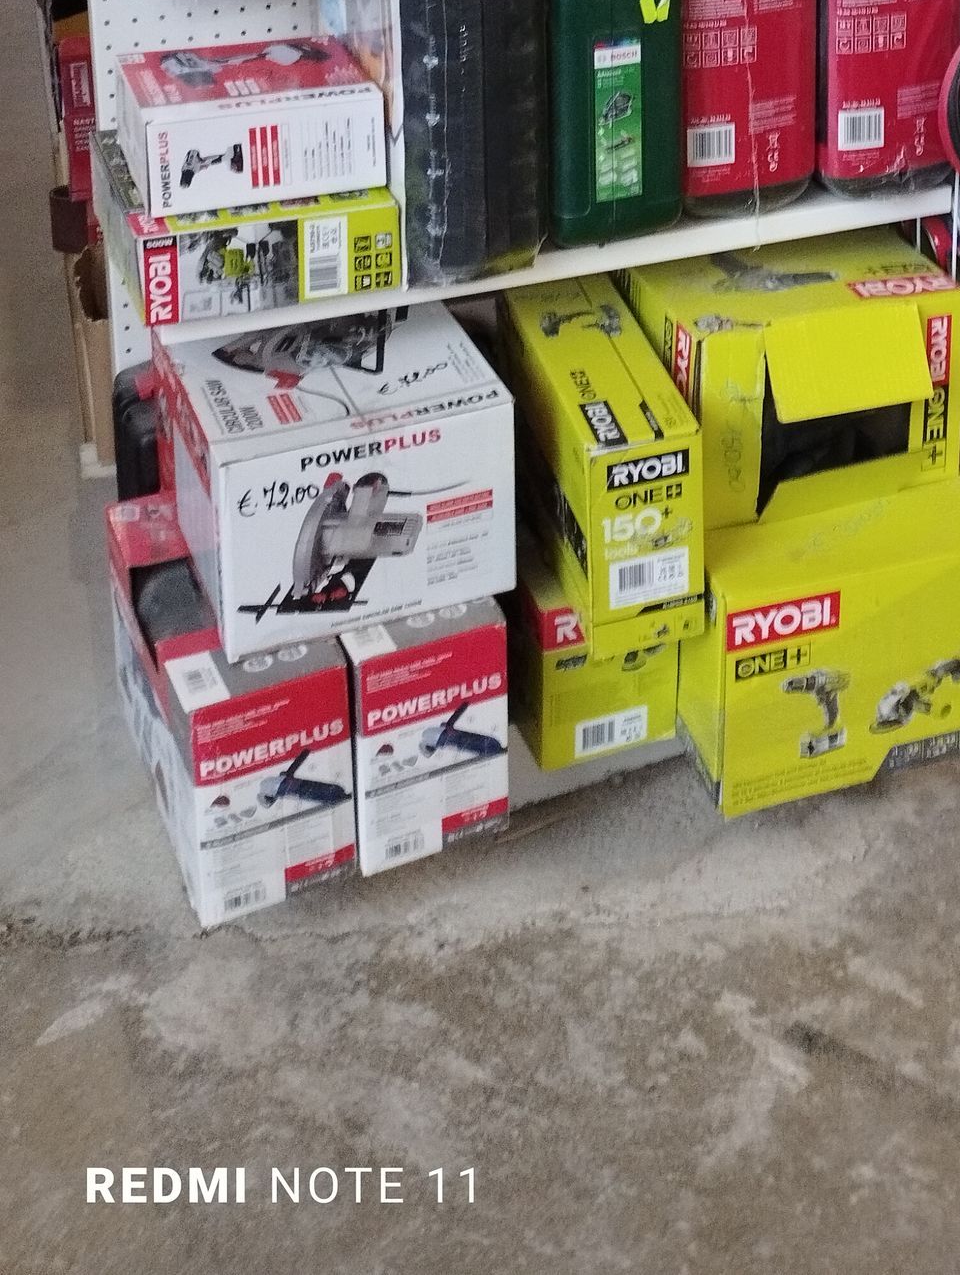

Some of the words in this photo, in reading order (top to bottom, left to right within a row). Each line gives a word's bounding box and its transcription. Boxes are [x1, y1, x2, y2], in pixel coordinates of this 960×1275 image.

[156, 130, 173, 210] POWERPLUS
[150, 253, 173, 324] RYOBI
[929, 315, 951, 383] RYOBI
[300, 428, 442, 472] POWERPLUS
[612, 452, 683, 488] RYOBI
[732, 597, 832, 646] RYOBI
[366, 674, 503, 728] POWERPLUS
[199, 717, 345, 779] POWERPLUS
